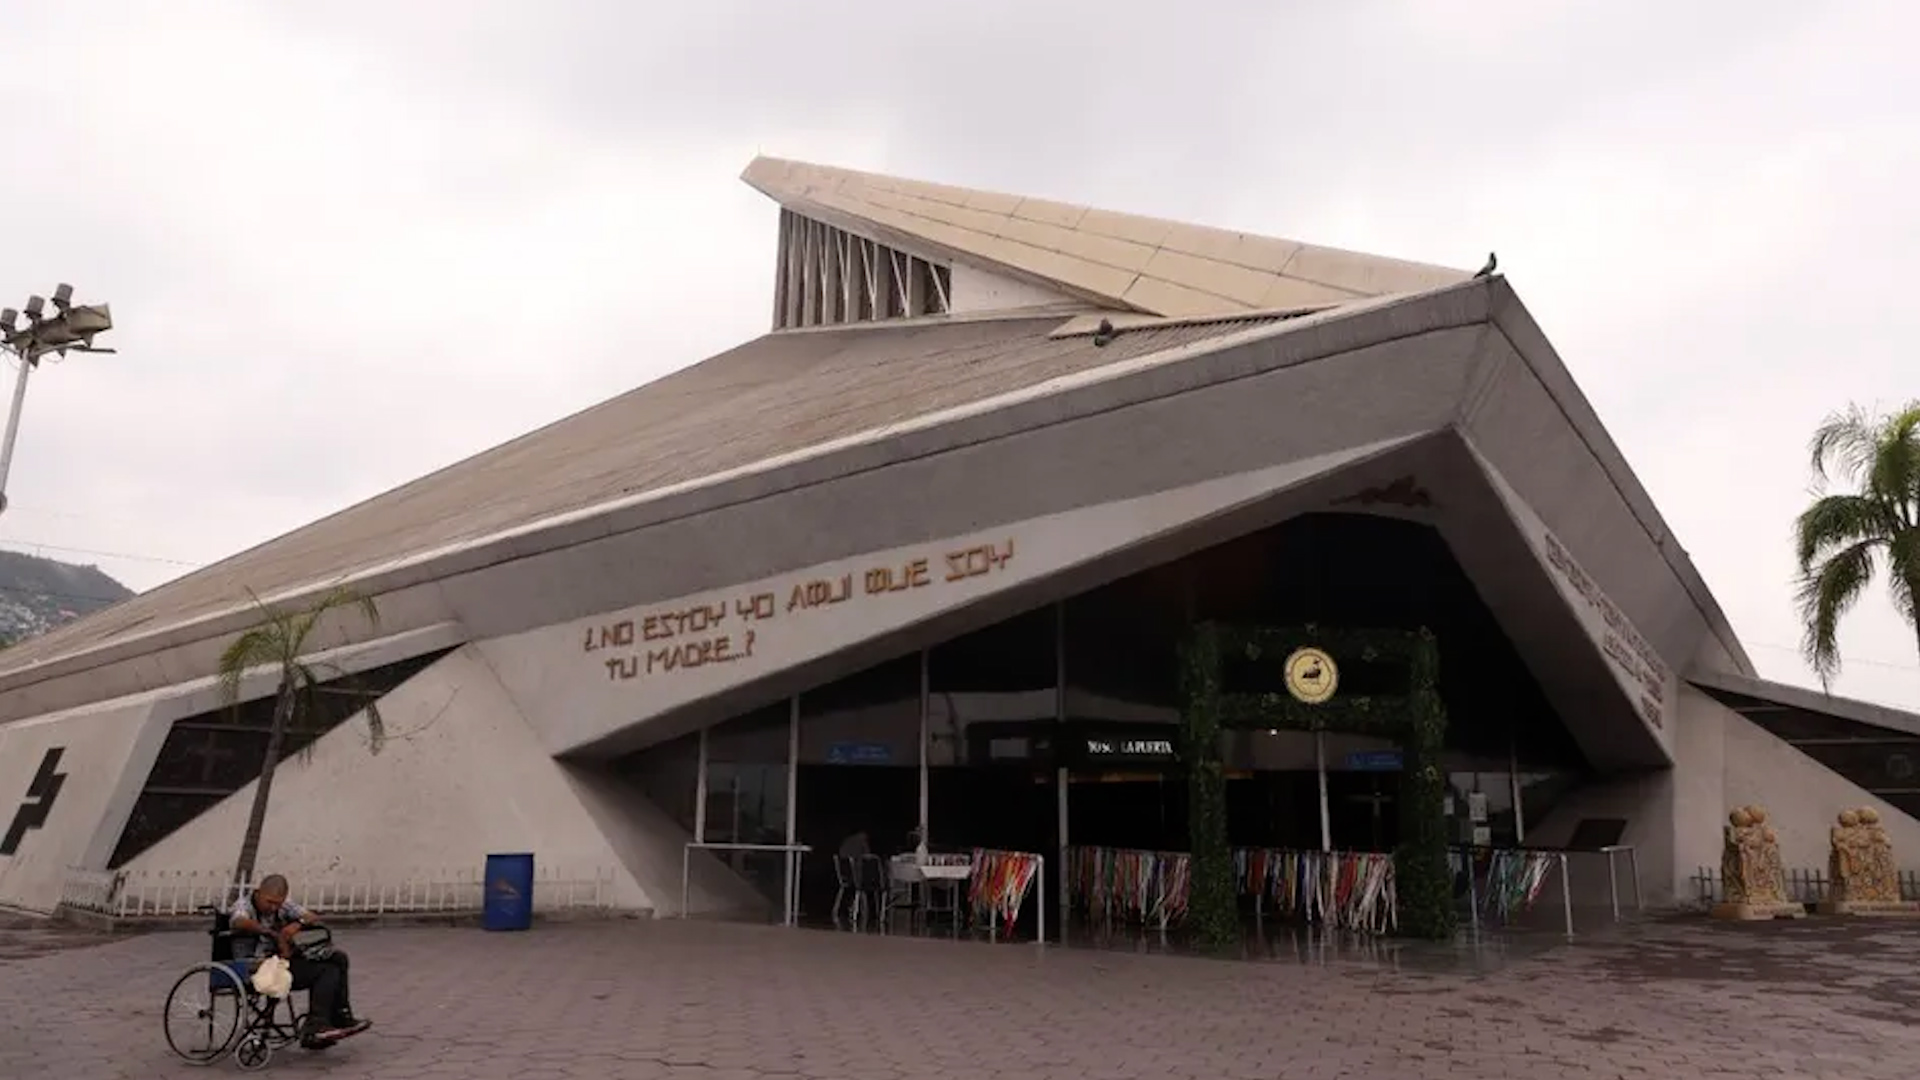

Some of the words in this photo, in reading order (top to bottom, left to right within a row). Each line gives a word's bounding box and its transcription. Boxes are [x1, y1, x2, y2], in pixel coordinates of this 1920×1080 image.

[643, 601, 726, 640] ESTOY
[736, 593, 775, 621] YO
[787, 573, 852, 613] AQUI
[865, 557, 931, 595] QUE
[946, 539, 1014, 582] SOY
[606, 656, 638, 680] TU
